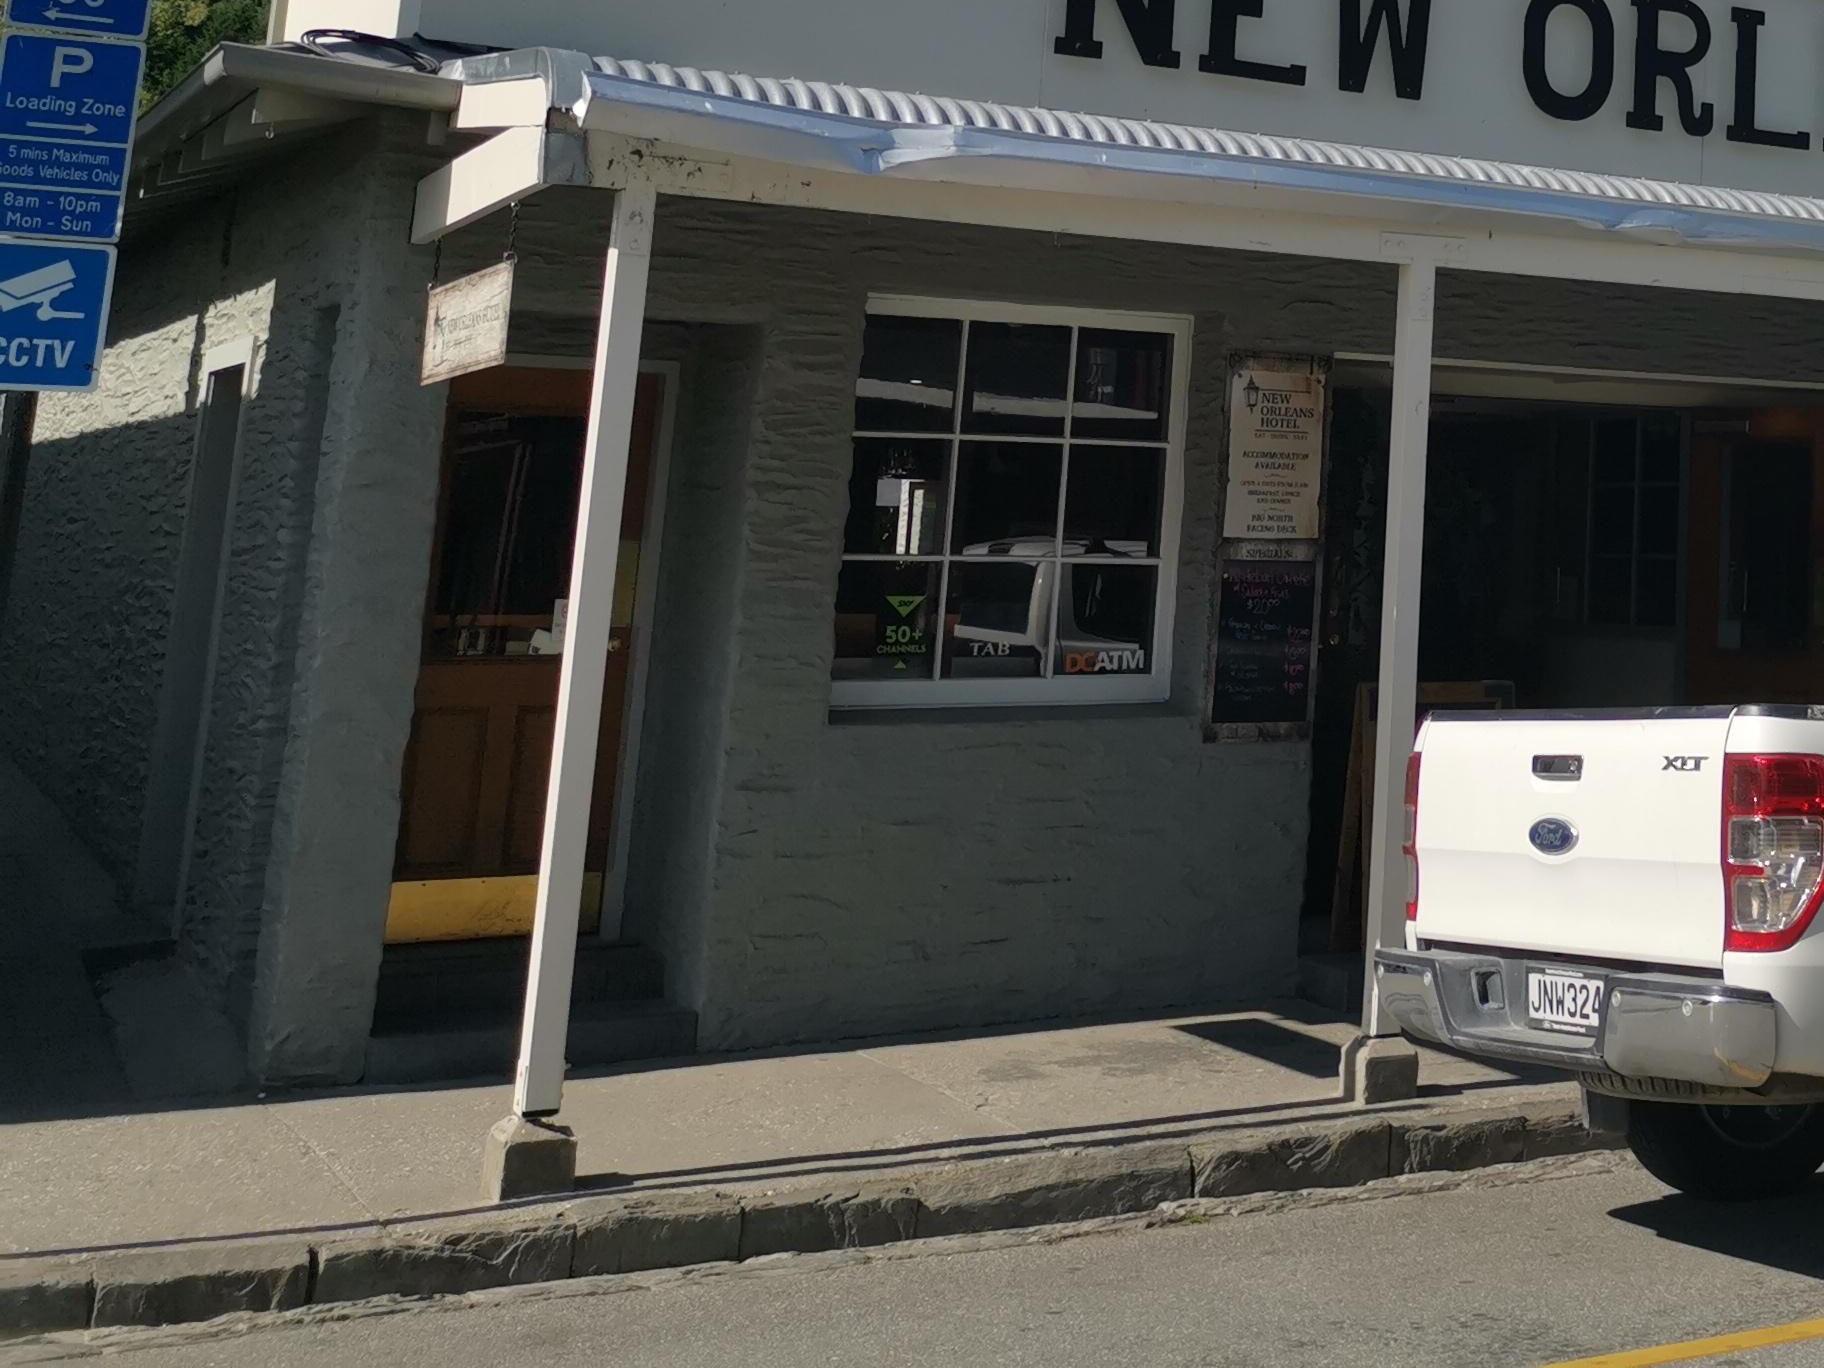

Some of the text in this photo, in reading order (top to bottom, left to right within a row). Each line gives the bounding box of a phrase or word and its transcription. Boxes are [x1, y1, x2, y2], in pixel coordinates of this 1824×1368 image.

[50, 45, 94, 88] P
[5, 91, 127, 117] Loading Zone
[8, 144, 110, 166] 5 mins Maximum
[39, 164, 89, 181] Vehicles
[91, 169, 121, 186] Only
[3, 191, 40, 208] 8am
[58, 195, 101, 214] 10pm
[5, 211, 42, 229] Mon
[60, 216, 92, 233] Sun
[1261, 393, 1292, 405] NEW
[1260, 405, 1315, 419] ORLEANS
[1260, 417, 1300, 429] HOTEL
[885, 625, 923, 643] 50+
[876, 644, 927, 654] CHANNELS
[968, 640, 1011, 657] TAB
[1661, 755, 1710, 772] XLT
[1534, 822, 1564, 846] Ford
[1531, 978, 1601, 1020] JNW324
